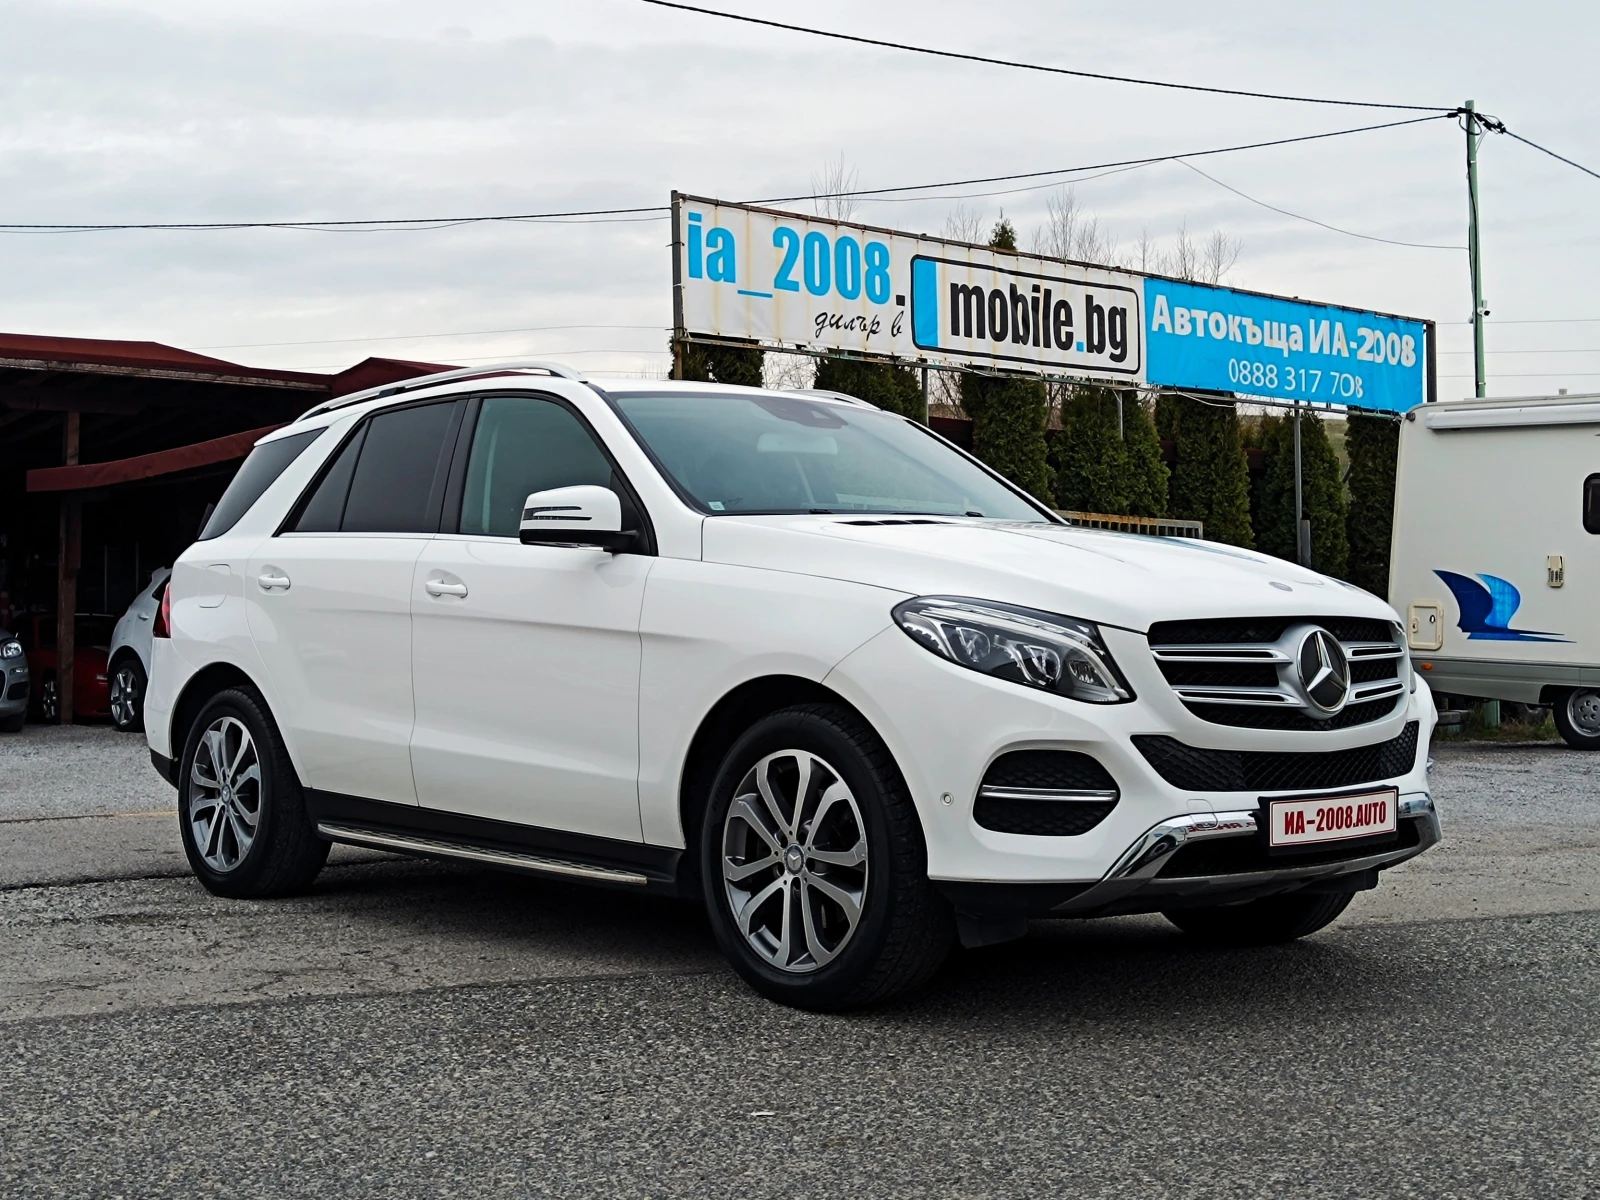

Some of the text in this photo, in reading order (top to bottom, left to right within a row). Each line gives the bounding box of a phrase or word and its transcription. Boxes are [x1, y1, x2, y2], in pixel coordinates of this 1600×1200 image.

[815, 310, 904, 341] дилър в
[950, 282, 1127, 363] mobile.bg
[1151, 295, 1416, 368] Автокъща ИА-2008
[1228, 358, 1364, 399] 0888 317 708
